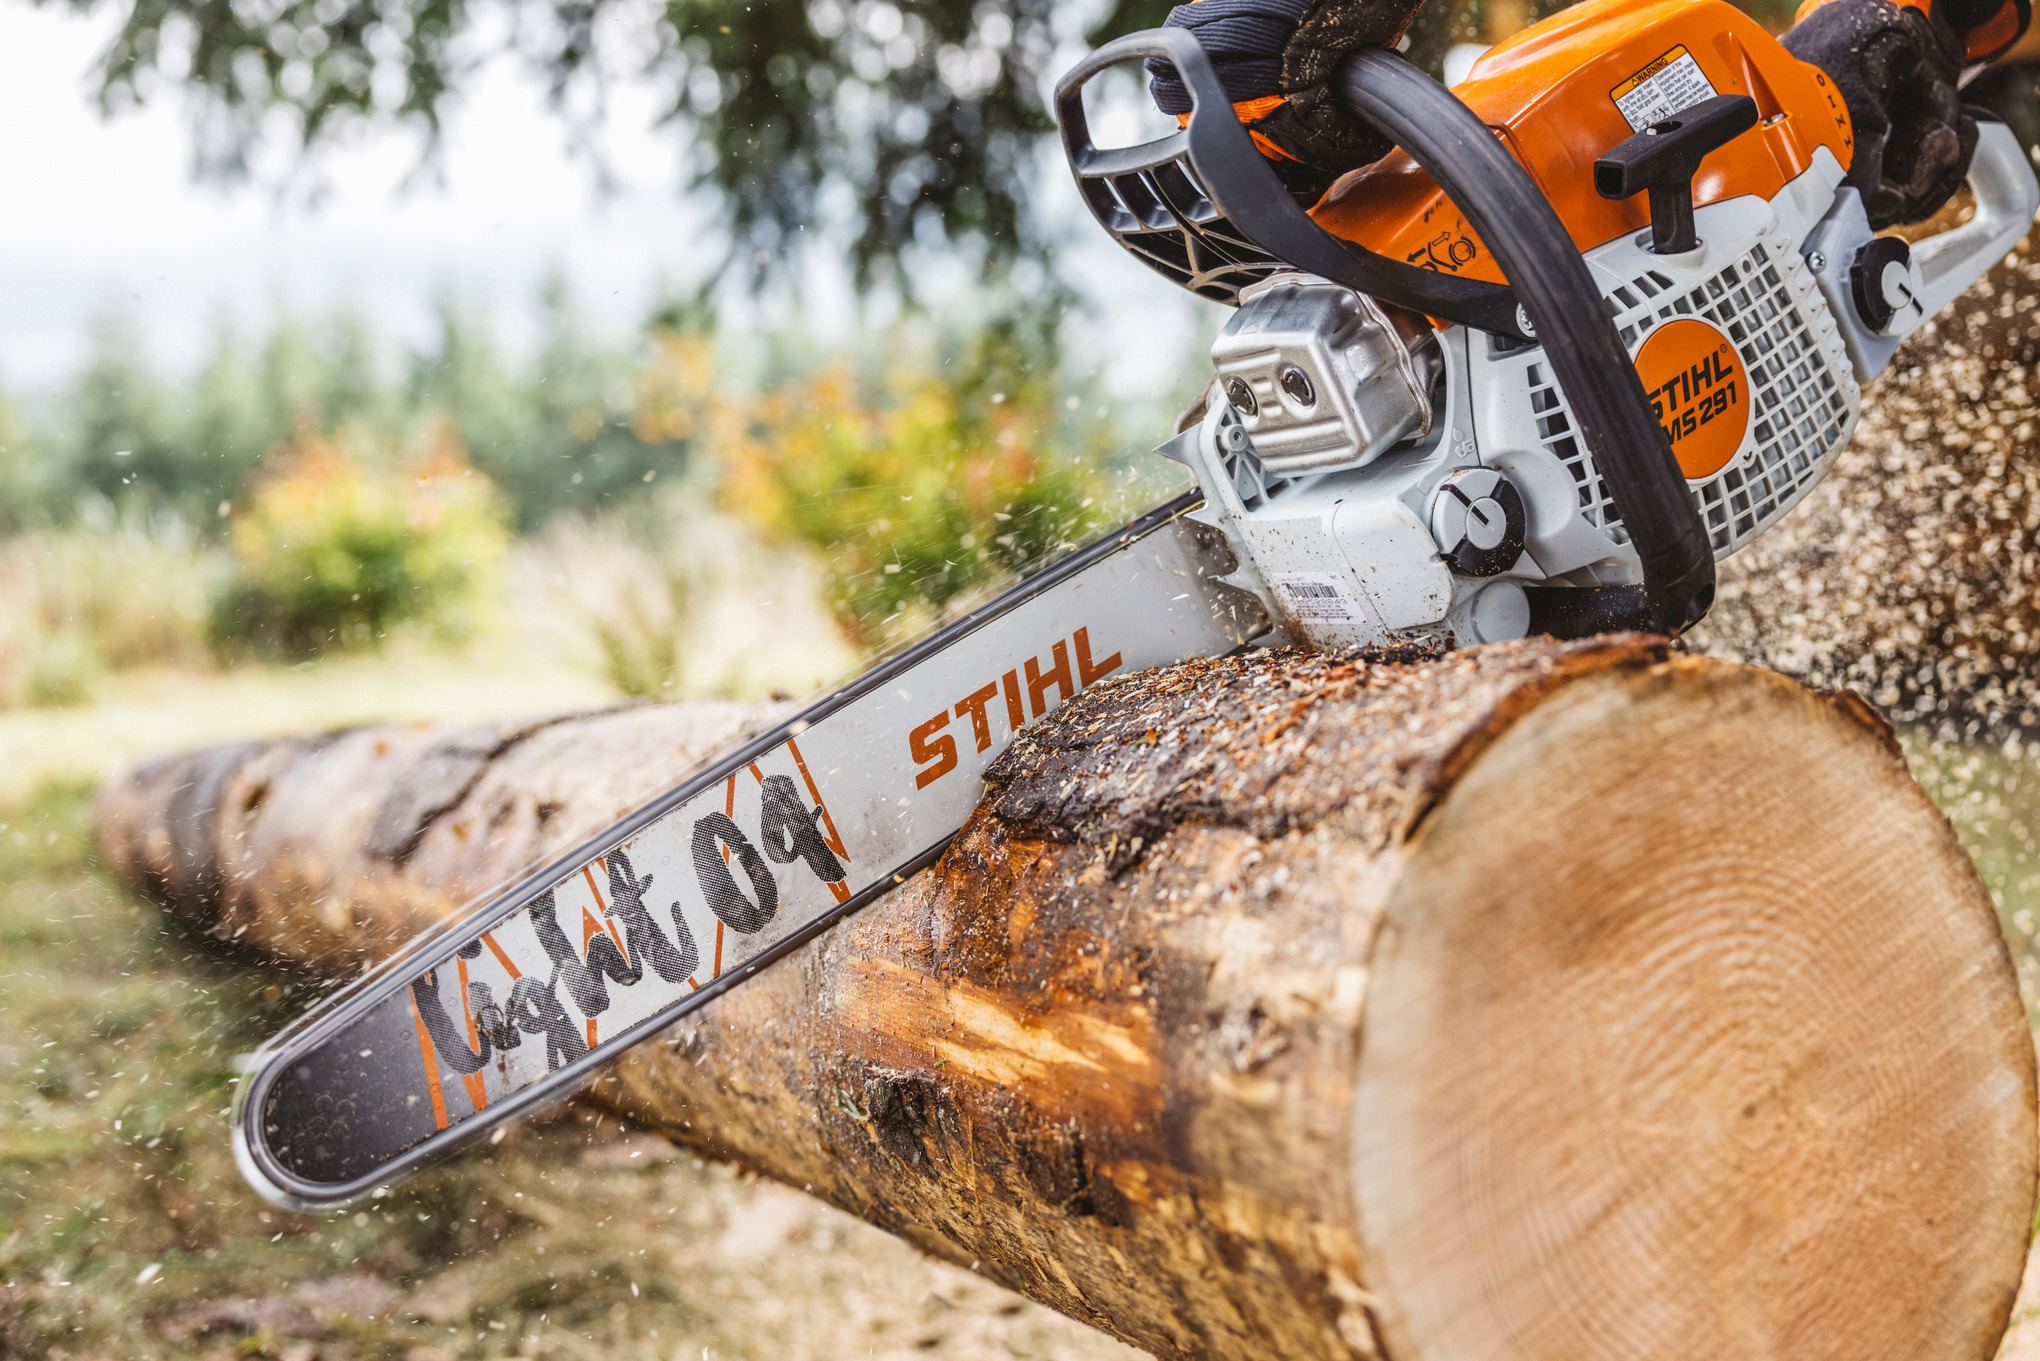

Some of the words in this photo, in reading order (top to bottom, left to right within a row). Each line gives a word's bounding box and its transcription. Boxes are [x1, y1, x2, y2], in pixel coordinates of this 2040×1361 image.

[1636, 58, 1668, 82] WARNING
[1699, 380, 1736, 426] 291
[909, 626, 1123, 790] STIHL
